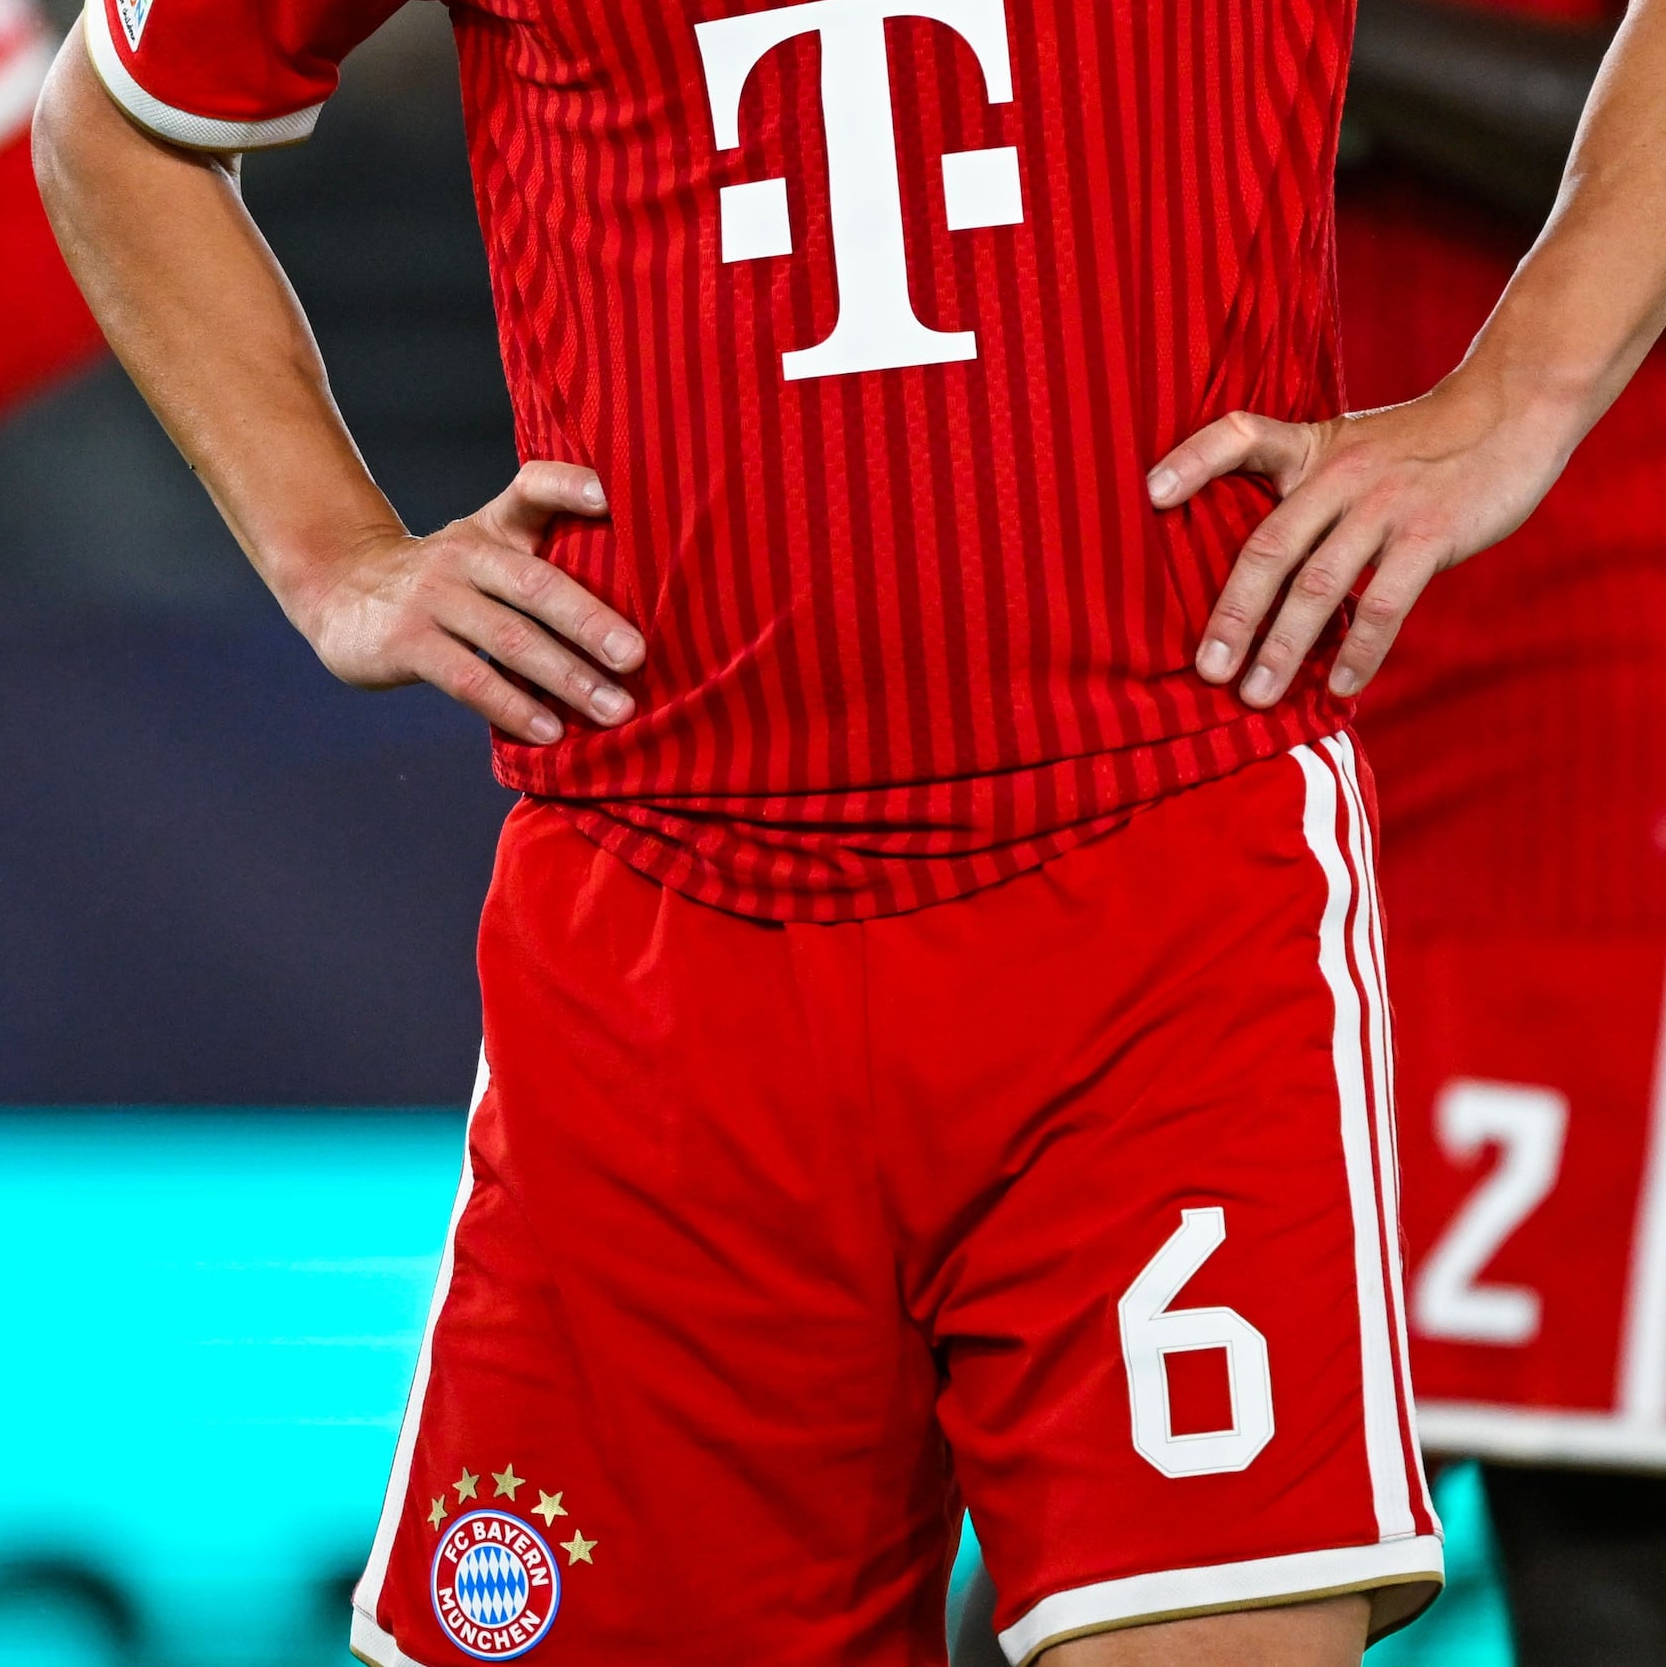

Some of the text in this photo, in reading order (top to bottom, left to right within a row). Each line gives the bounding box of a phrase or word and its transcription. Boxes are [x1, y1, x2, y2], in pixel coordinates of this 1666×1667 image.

[1412, 1080, 1569, 1344] 2
[1118, 1206, 1275, 1478] 6
[438, 1587, 542, 1651] MÜNCHEN
[444, 1521, 550, 1588] FC BAYERN
